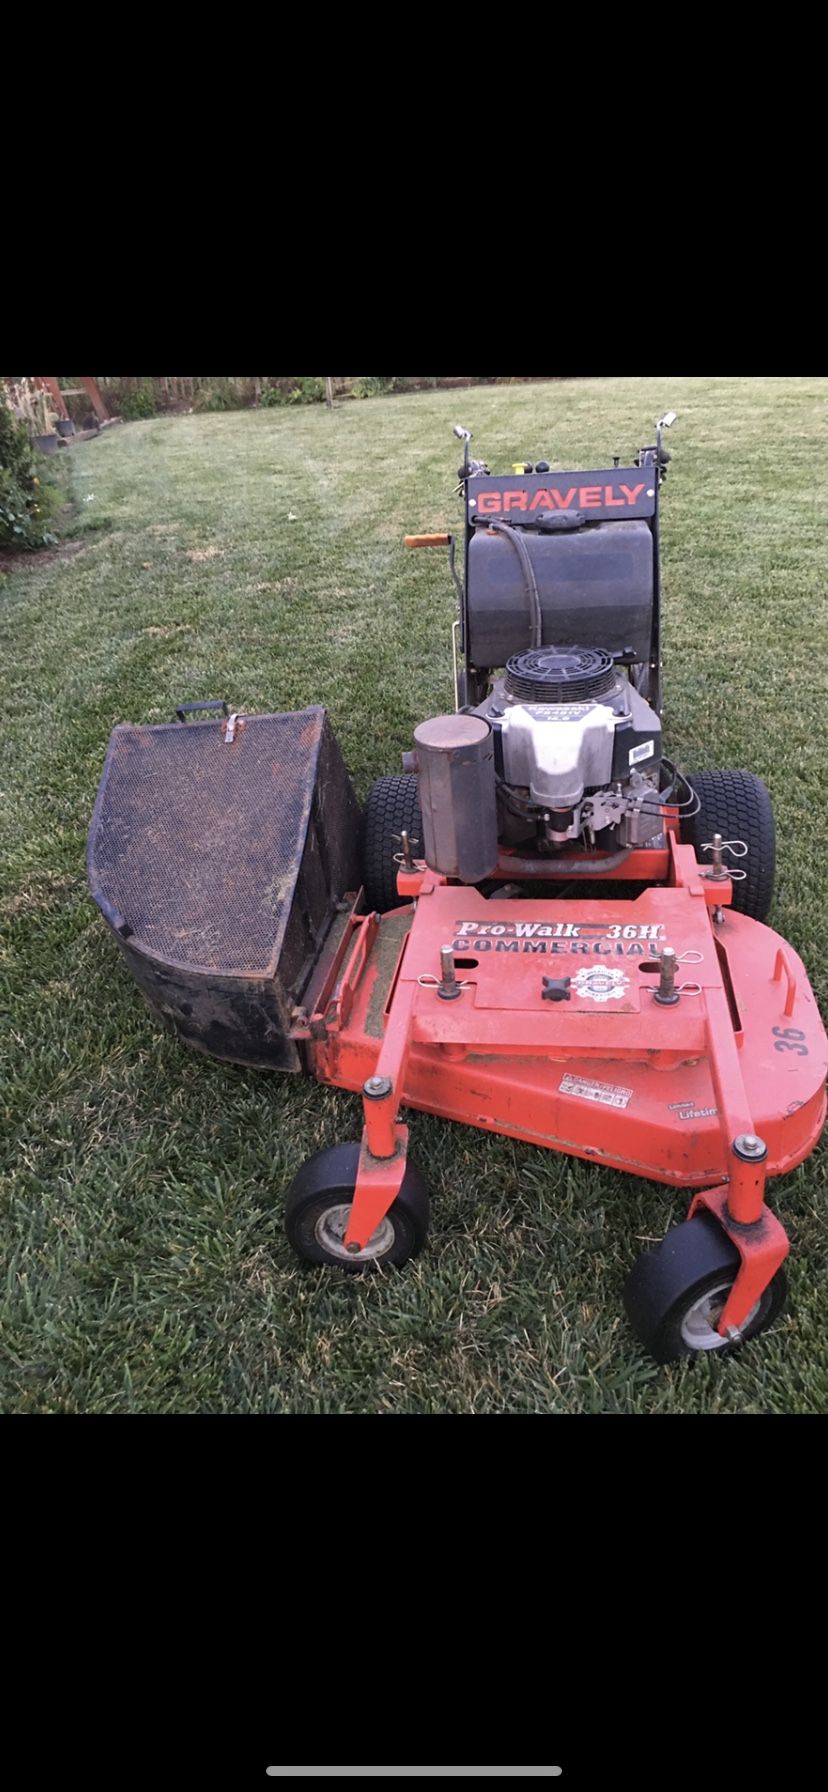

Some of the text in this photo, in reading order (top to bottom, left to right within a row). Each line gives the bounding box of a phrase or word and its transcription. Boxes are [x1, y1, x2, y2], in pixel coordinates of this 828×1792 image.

[477, 483, 645, 513] GRAVELY
[456, 921, 581, 938] Pro-Walk
[452, 939, 662, 957] COMMERCIAL
[771, 1025, 809, 1056] 36
[679, 1107, 718, 1119] Lifetim
